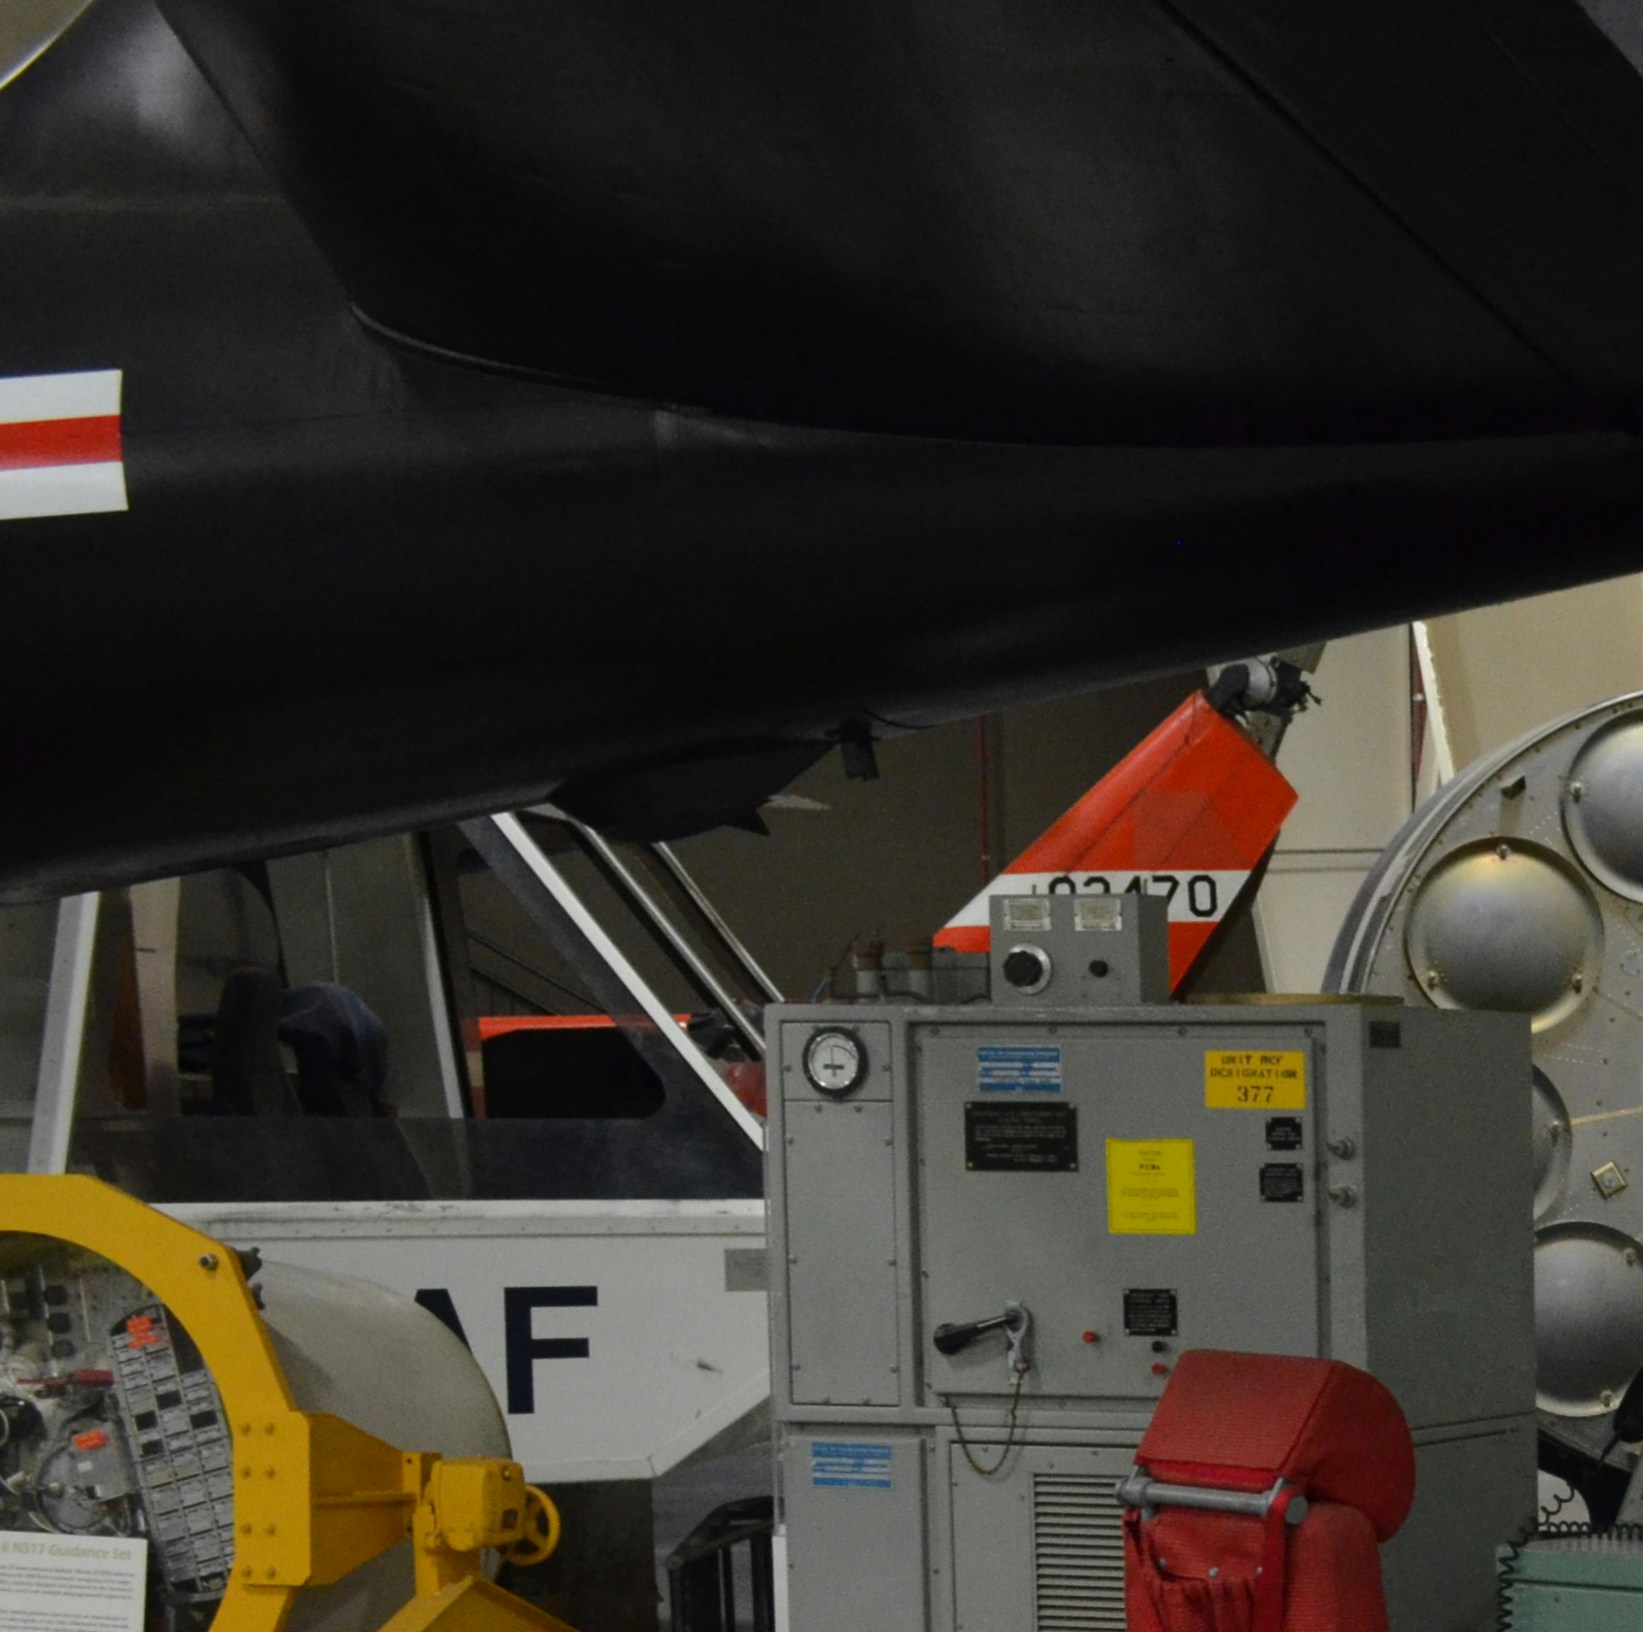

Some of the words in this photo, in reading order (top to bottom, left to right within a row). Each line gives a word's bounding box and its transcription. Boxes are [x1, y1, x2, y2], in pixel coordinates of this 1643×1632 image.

[1237, 1085, 1274, 1103] 377
[48, 1543, 110, 1559] Guidance
[113, 1547, 132, 1560] Set
